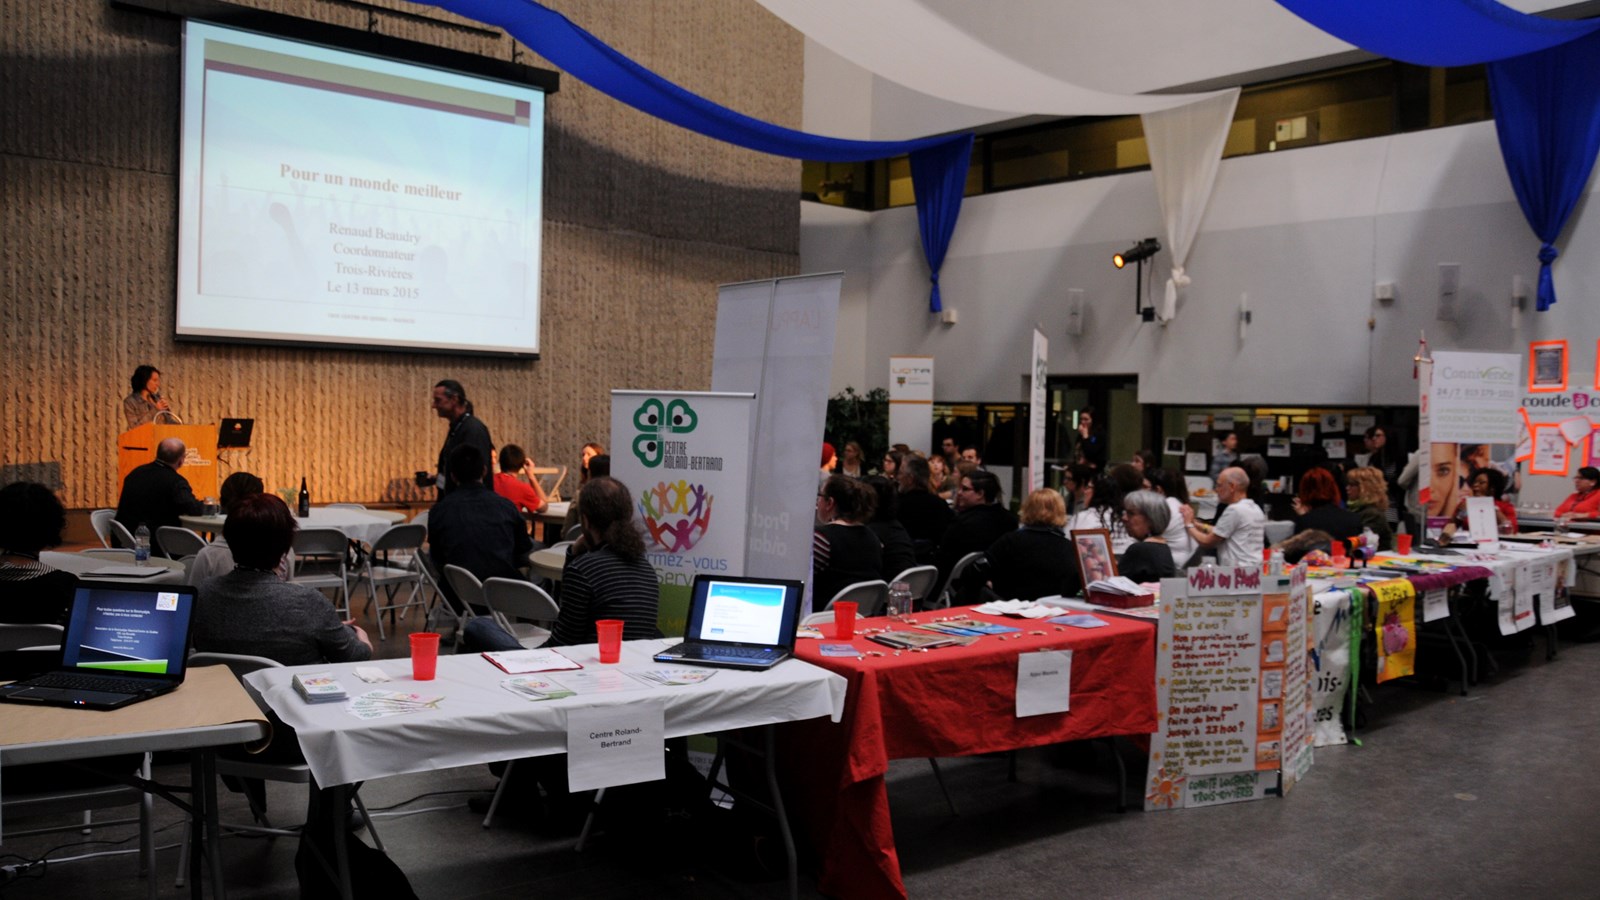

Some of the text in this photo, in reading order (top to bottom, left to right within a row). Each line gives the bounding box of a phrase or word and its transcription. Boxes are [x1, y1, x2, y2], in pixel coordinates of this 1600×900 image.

[280, 163, 462, 201] Pour un monde meilleur
[329, 222, 421, 245] Renaud Beaudry
[333, 242, 416, 261] Coordonnateur
[334, 261, 413, 280] Trois-Rivières
[327, 280, 420, 299] Le 13 mars 2015
[1522, 394, 1571, 407] coude
[664, 441, 687, 455] CENTRE
[664, 455, 723, 471] ROLAND-BERTRAND
[647, 553, 728, 571] rmez-vous
[654, 567, 697, 586] Serv
[589, 727, 643, 740] Centre Roland-
[600, 738, 632, 748] Bertrand
